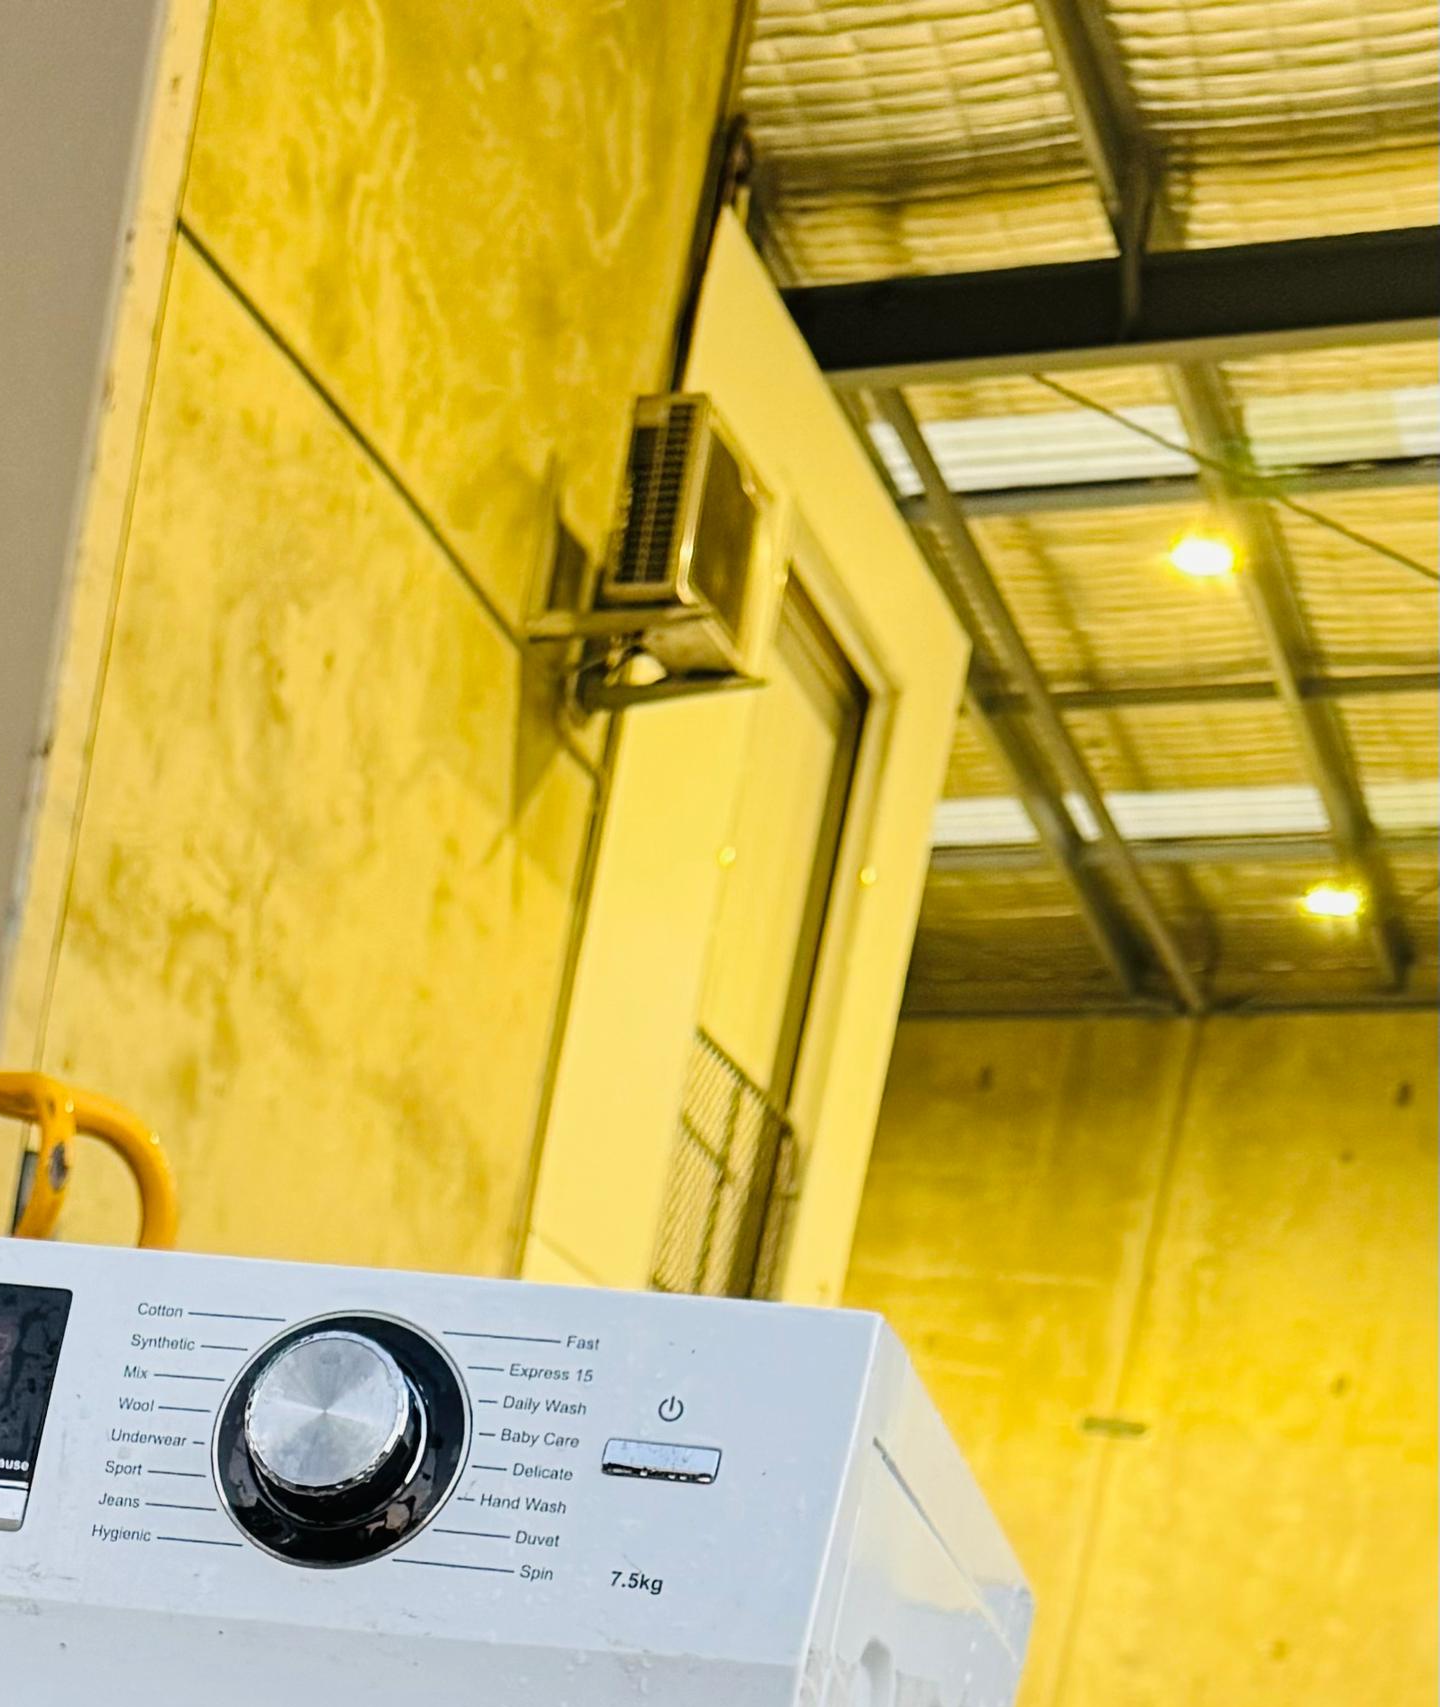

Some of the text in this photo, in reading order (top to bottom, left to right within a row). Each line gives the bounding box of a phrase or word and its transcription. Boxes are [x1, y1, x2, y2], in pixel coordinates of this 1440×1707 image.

[137, 1302, 183, 1318] Cotton
[131, 1333, 196, 1351] Synthetic
[566, 1335, 600, 1350] Fast
[123, 1365, 149, 1379] Mix
[509, 1363, 593, 1382] Express 15
[119, 1396, 155, 1412] Wool
[503, 1395, 587, 1415] Daily Wash
[111, 1428, 187, 1447] Underwear
[501, 1428, 580, 1448] Baby Care
[105, 1460, 142, 1477] Sport
[512, 1462, 574, 1481] Delicate
[98, 1492, 140, 1508] Jeans
[480, 1493, 567, 1514] Hand Wash
[91, 1524, 152, 1542] Hygienic
[515, 1530, 560, 1547] Duvet
[519, 1565, 554, 1582] Spin
[611, 1571, 664, 1595] 7.5kg
